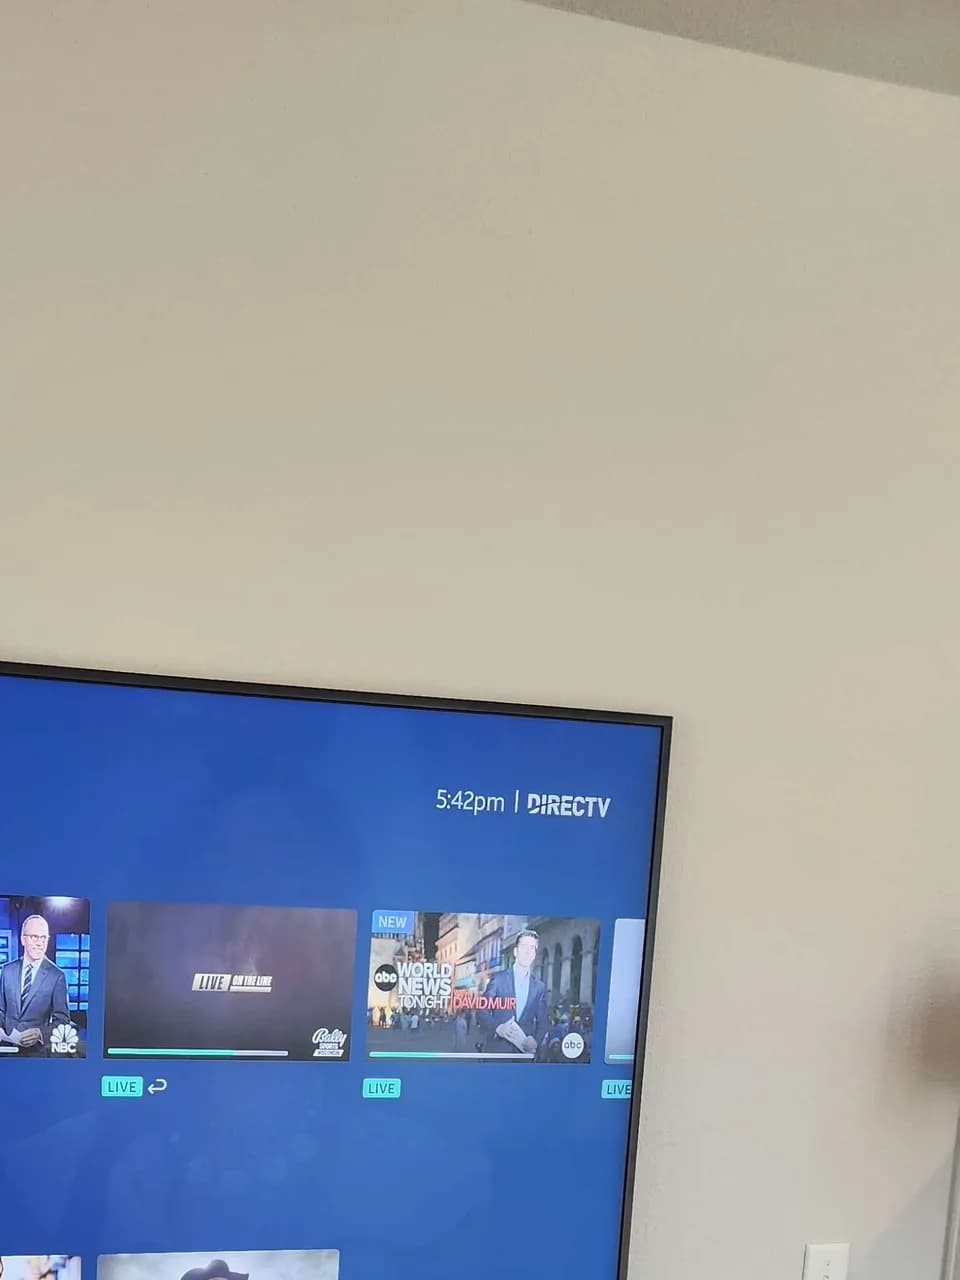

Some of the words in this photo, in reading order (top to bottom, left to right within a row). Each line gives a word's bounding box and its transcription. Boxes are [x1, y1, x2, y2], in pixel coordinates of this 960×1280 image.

[436, 789, 505, 815] 5:42pm
[527, 793, 611, 818] DIRECTV
[378, 914, 407, 929] NEW
[374, 970, 398, 984] abc
[397, 961, 452, 979] WORLD
[199, 975, 224, 990] LIVE
[398, 977, 452, 995] NEWS
[398, 995, 451, 1009] TONIGHT
[488, 997, 517, 1010] MUIR
[312, 1027, 347, 1048] Bally
[51, 1042, 77, 1054] NBC
[563, 1040, 582, 1051] abc
[107, 1081, 137, 1093] LIVE
[368, 1082, 394, 1094] LIVE
